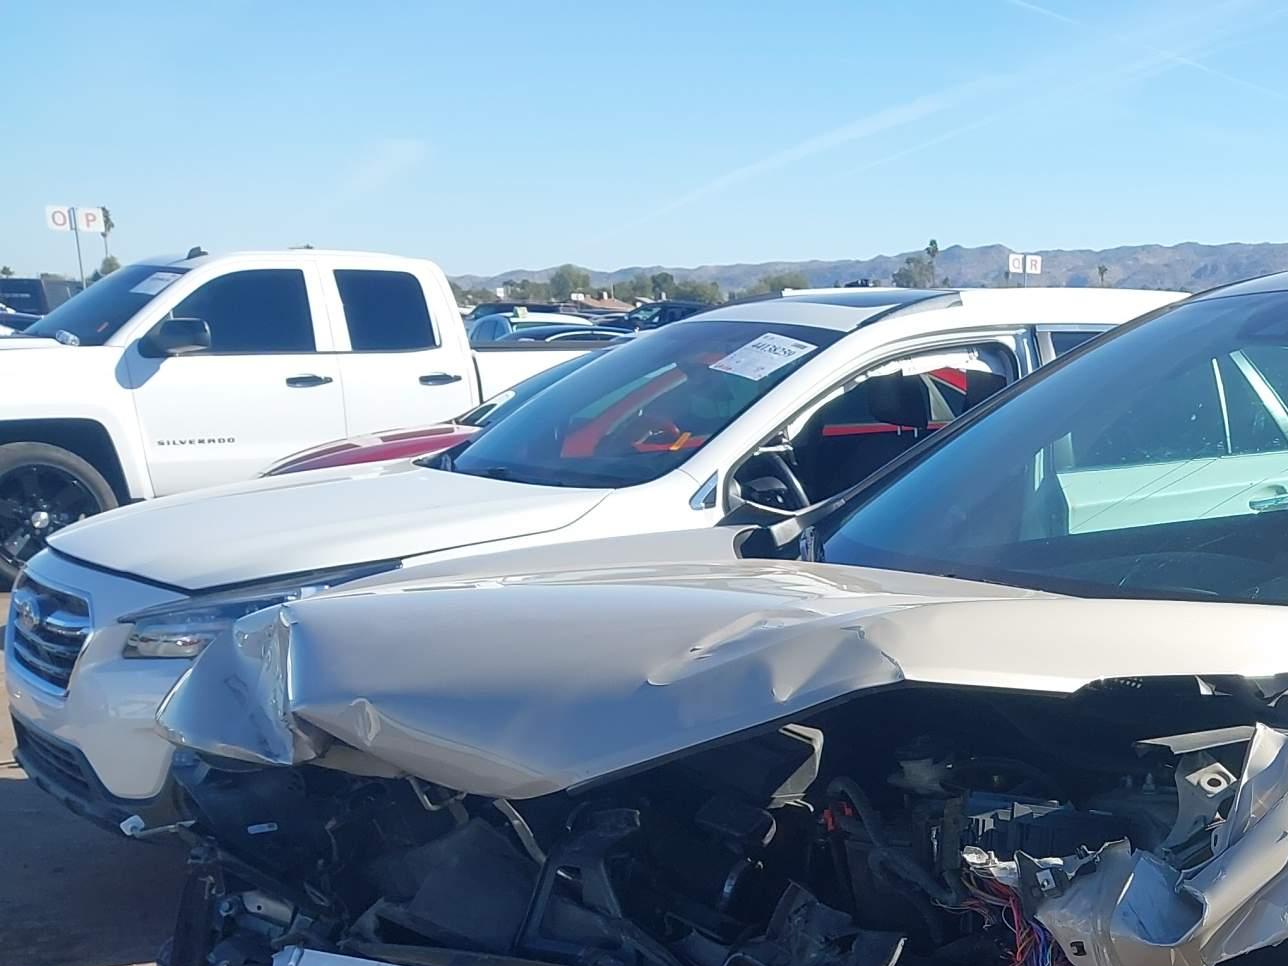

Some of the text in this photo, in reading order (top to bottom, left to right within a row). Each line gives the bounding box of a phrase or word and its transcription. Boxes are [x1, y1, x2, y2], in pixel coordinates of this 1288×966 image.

[51, 210, 67, 227] O
[84, 212, 97, 229] P
[157, 437, 236, 446] SILVERADO
